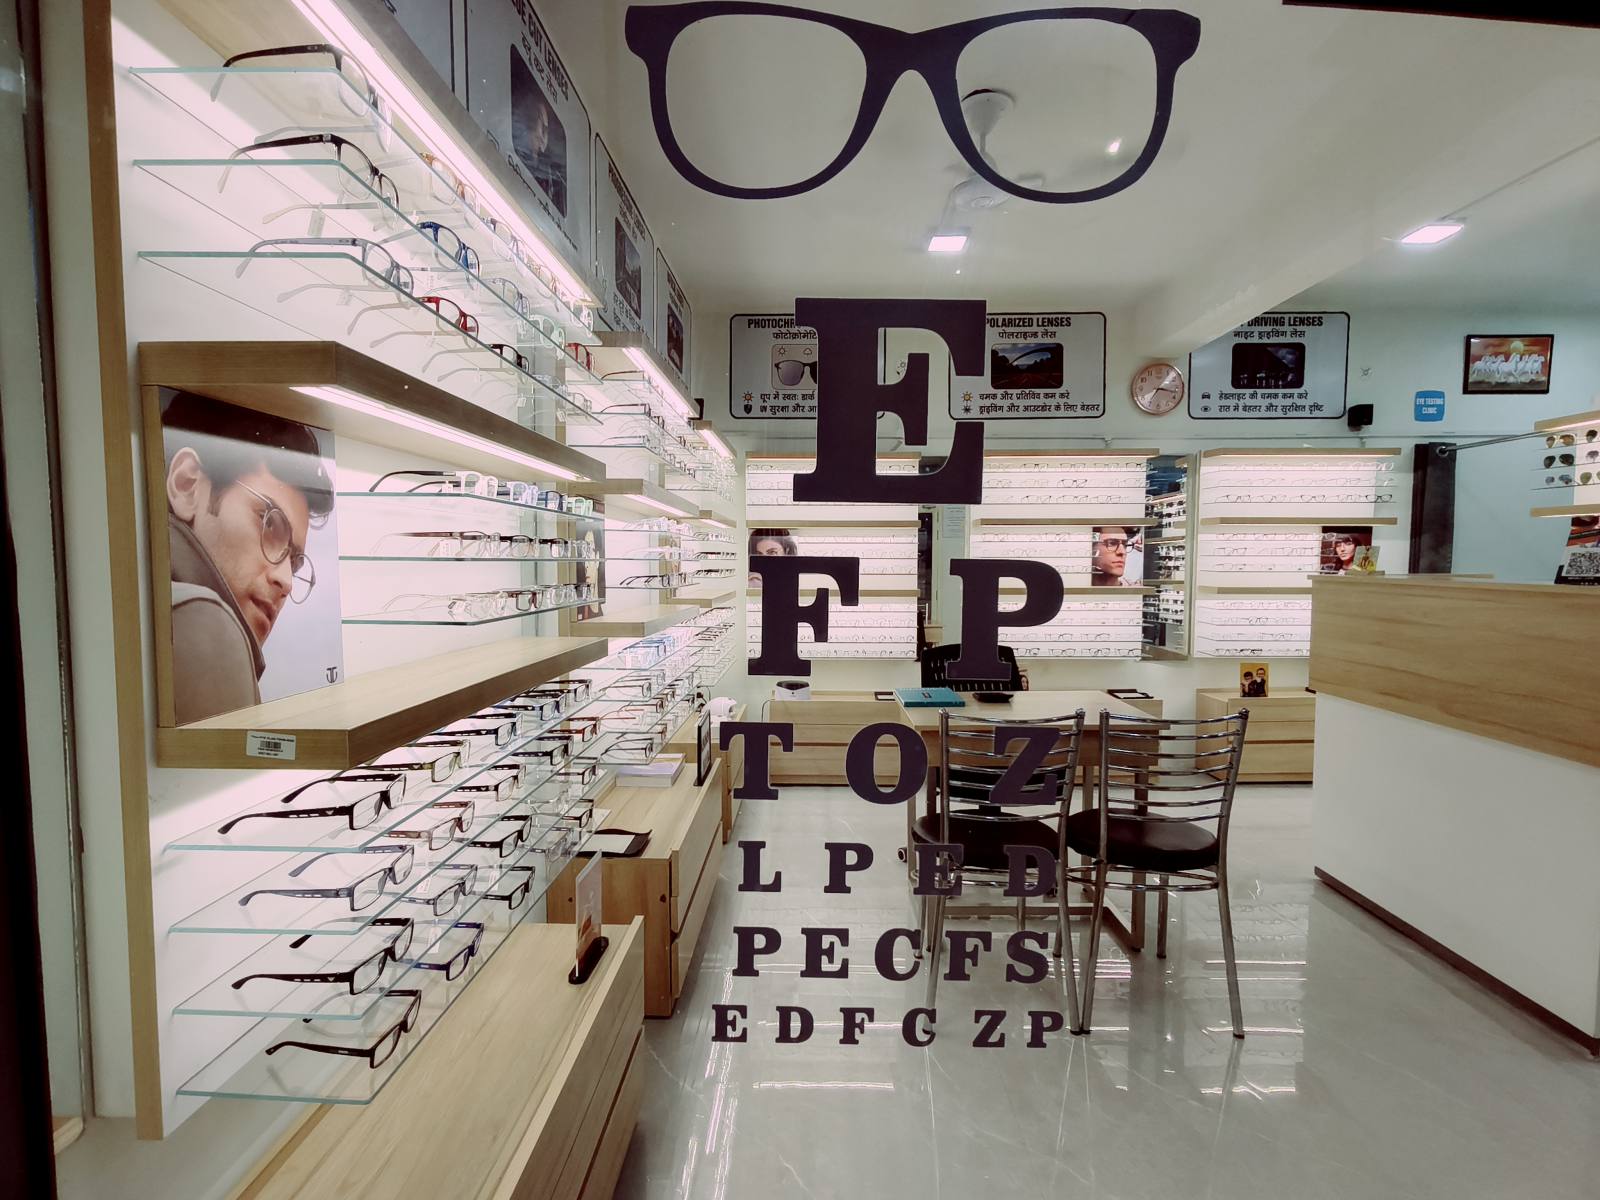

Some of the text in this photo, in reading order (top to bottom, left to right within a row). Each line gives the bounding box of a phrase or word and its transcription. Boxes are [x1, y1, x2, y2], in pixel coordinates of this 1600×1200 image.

[747, 318, 796, 329] PHOTOCHR
[1036, 317, 1072, 328] LENSES
[1247, 316, 1324, 327] DRIVING LENSES
[772, 329, 818, 340] फोटोक्रोमेटि
[795, 297, 987, 504] E
[807, 405, 817, 413] आ
[748, 556, 1065, 680] F P
[719, 721, 793, 800] T
[845, 722, 928, 804] O
[990, 726, 1061, 805] Z
[738, 840, 1057, 897] L P E D
